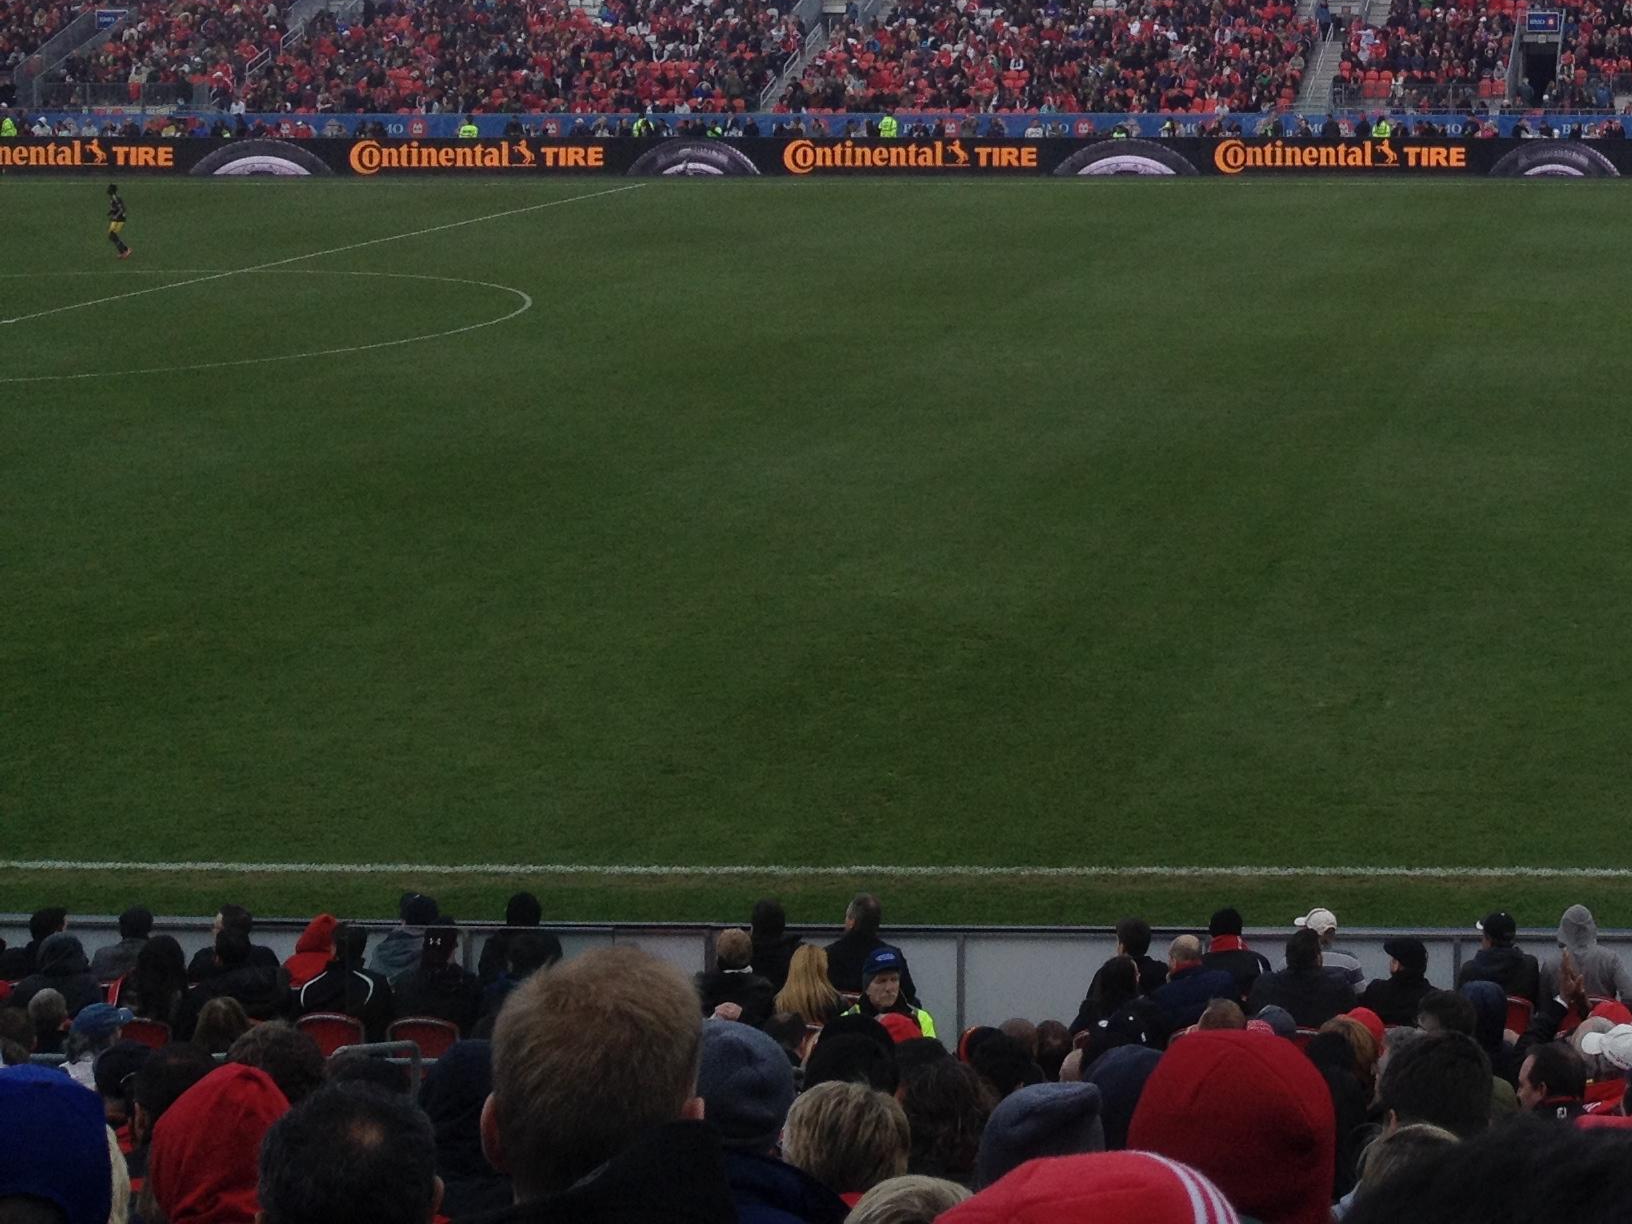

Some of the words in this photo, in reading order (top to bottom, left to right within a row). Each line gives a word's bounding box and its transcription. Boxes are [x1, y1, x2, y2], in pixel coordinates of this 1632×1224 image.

[112, 146, 174, 166] TIRE
[349, 139, 510, 175] Continental
[540, 146, 605, 166] TIRE
[783, 139, 943, 174] Continental
[974, 146, 1038, 167] TIRE
[1214, 139, 1373, 174] Continental
[1403, 146, 1466, 167] TIRE
